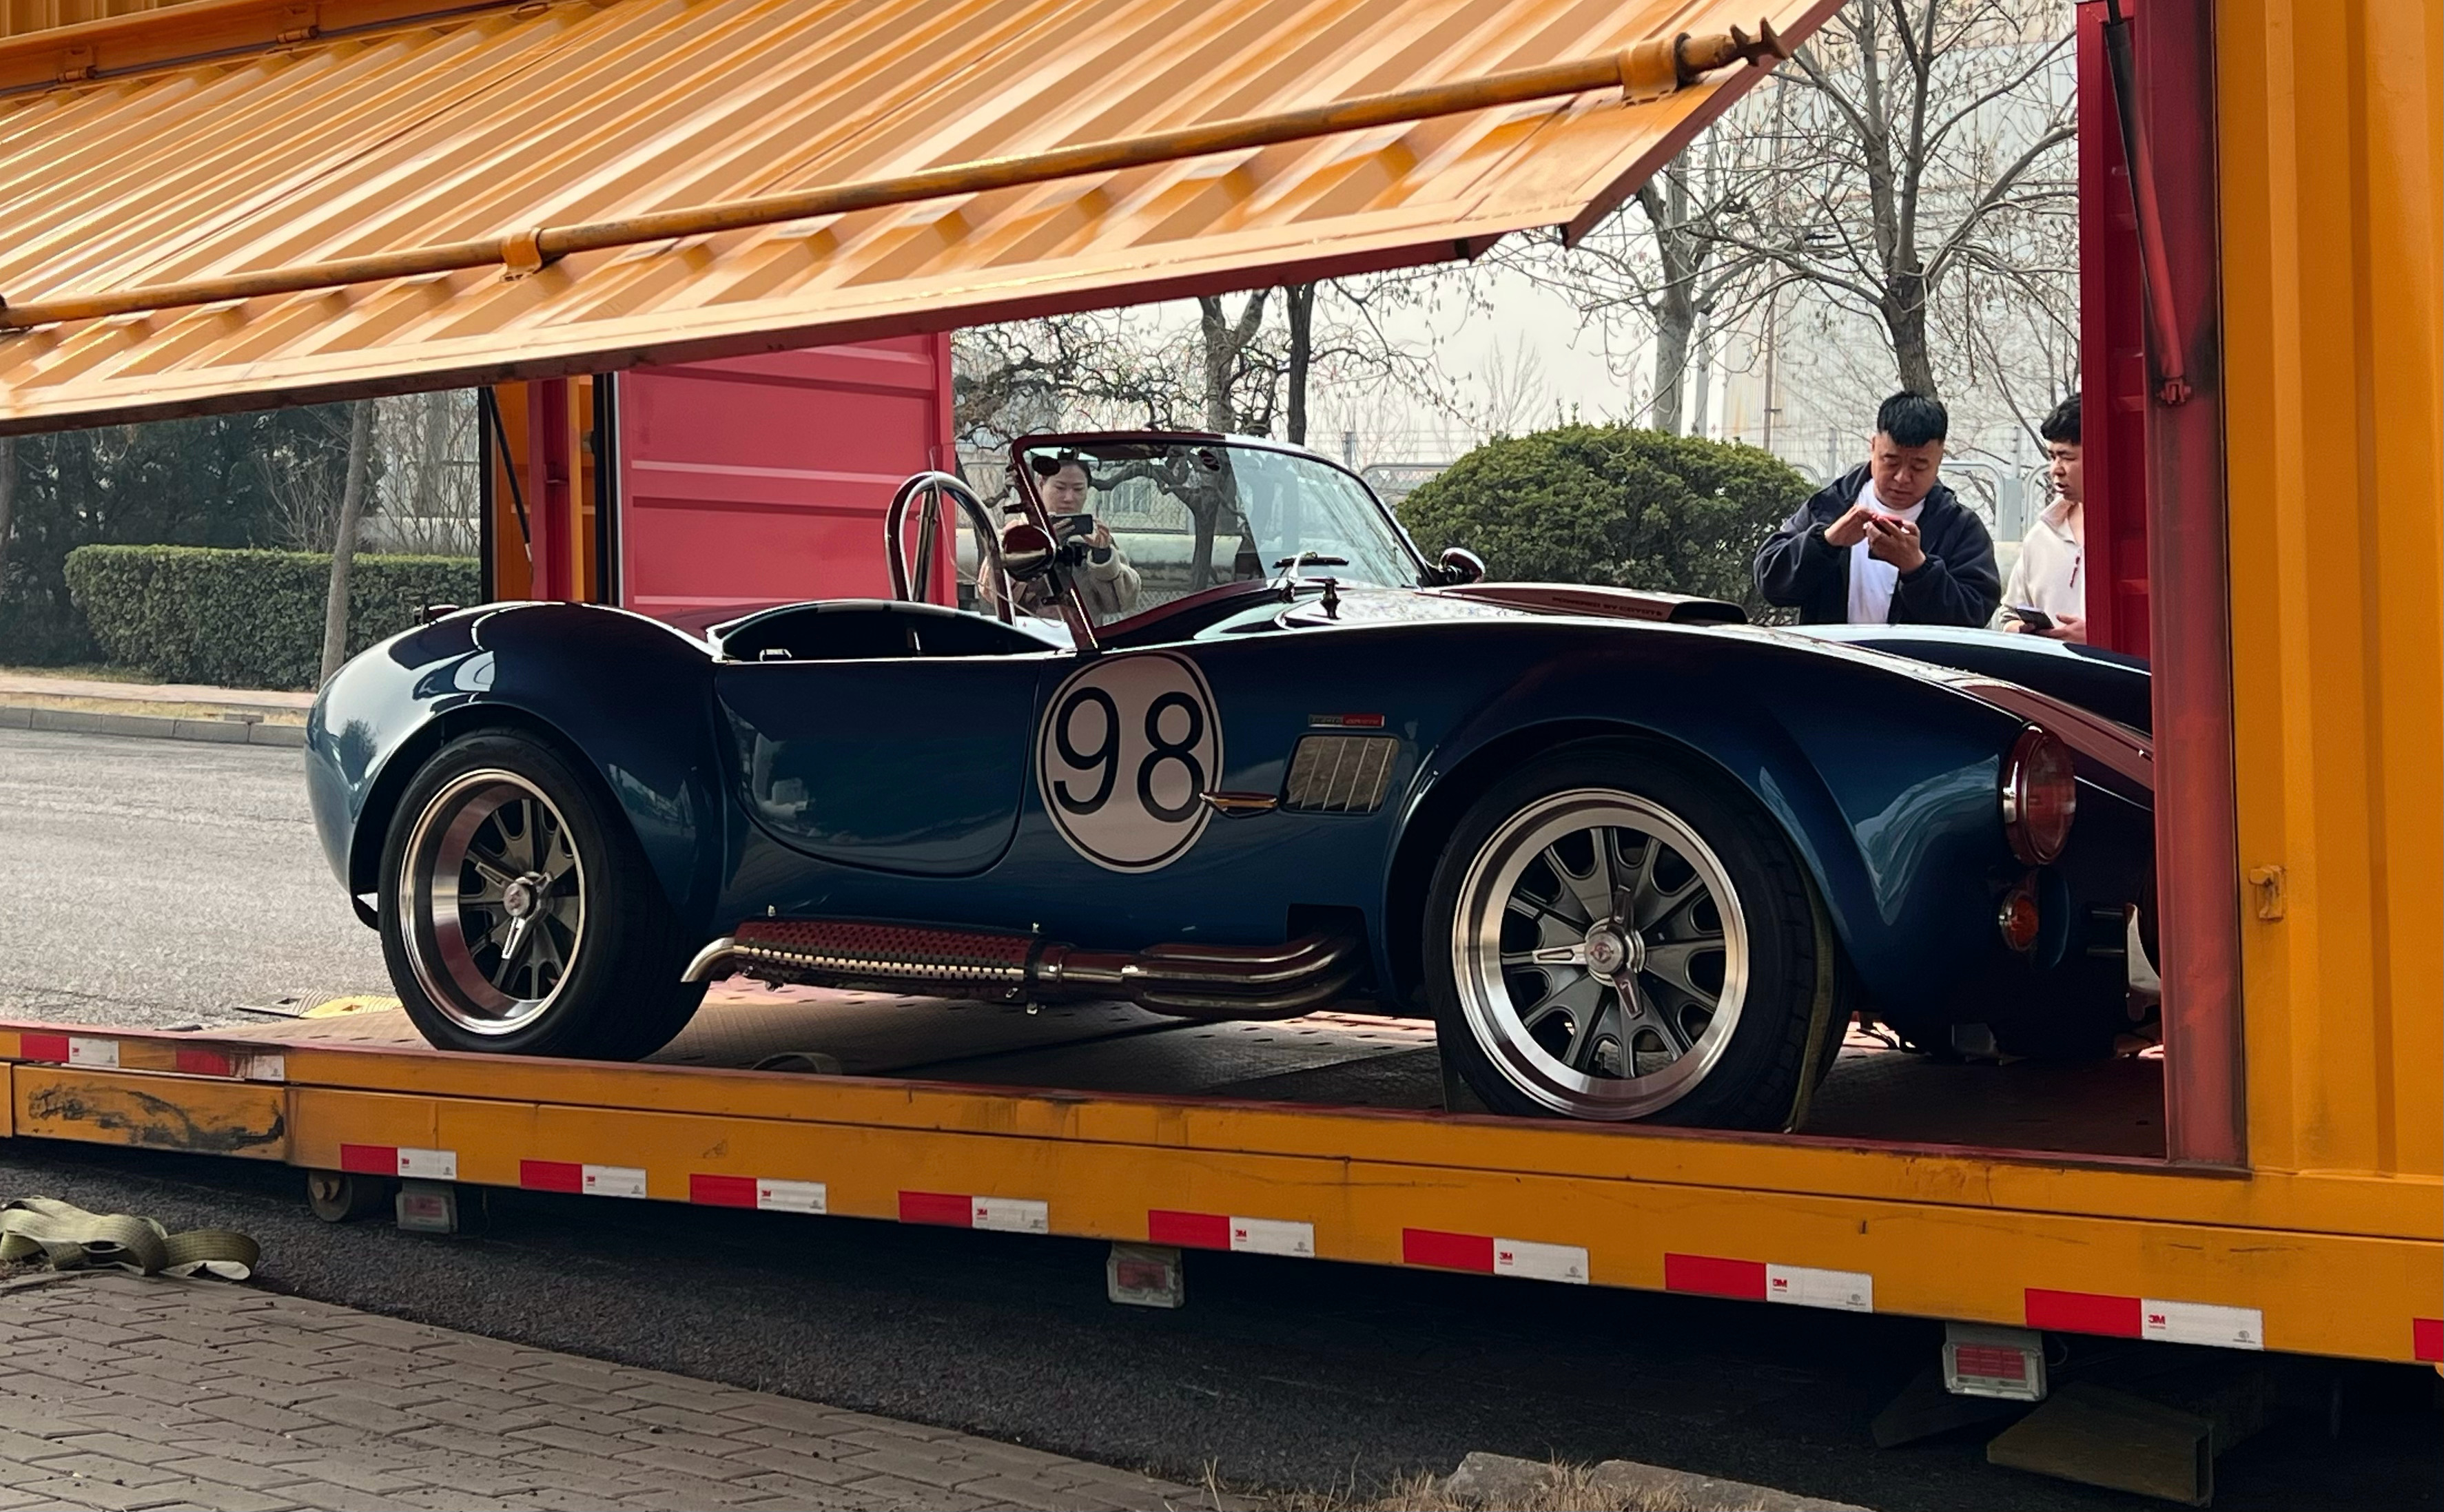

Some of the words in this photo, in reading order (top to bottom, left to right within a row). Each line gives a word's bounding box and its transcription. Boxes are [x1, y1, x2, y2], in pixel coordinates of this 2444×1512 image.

[1054, 687, 1204, 822] 98
[1499, 1252, 1512, 1261] 3M
[2148, 1314, 2166, 1325] 3M
